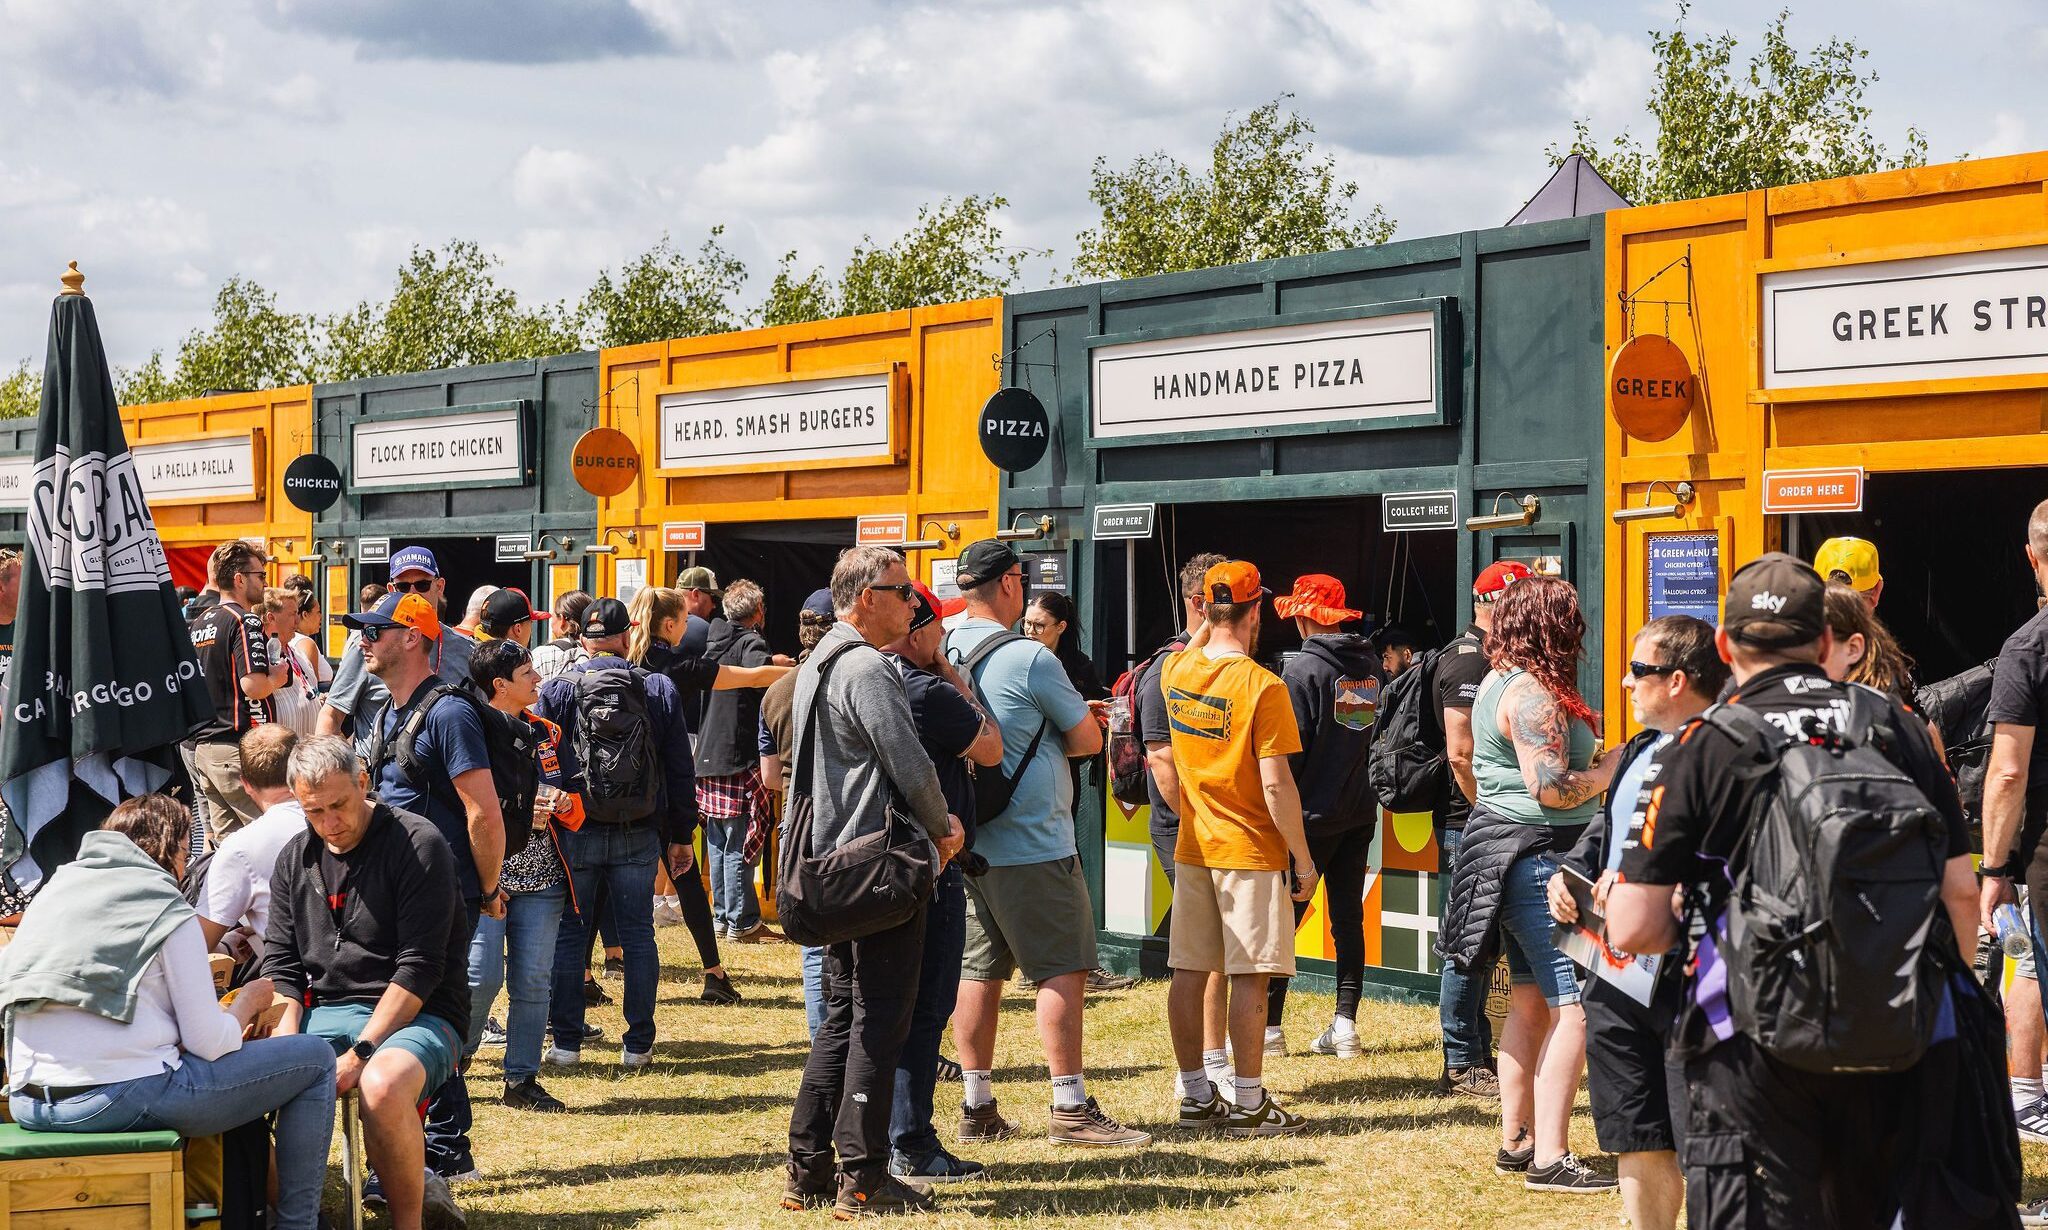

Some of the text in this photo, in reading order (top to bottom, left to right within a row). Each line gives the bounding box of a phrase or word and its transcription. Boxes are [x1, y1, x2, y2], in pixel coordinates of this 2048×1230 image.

[1832, 302, 1949, 342] GREEK
[1154, 358, 1364, 400] HANDMADE PIZZA
[1616, 377, 1687, 398] GREEK
[674, 405, 875, 442] HEARD. SMASH BURGERS
[986, 419, 1044, 437] PIZZA
[371, 436, 503, 464] FLOCK FRIED CHICKEN
[152, 459, 234, 480] LA PAELLA PAELLA
[576, 456, 636, 469] BURGER
[0, 475, 19, 489] UBAO
[286, 477, 339, 489] CHICKEN
[1779, 484, 1845, 497] ORDER HERE
[1391, 505, 1449, 517] COLLECT HERE
[1103, 516, 1143, 526] ORDER HERE
[861, 526, 901, 535] COLLECT HERE
[402, 553, 432, 567] YAMAHA
[1661, 548, 1710, 558] GREEK MENU
[1752, 590, 1787, 614] sky
[1181, 704, 1221, 721] Columbia
